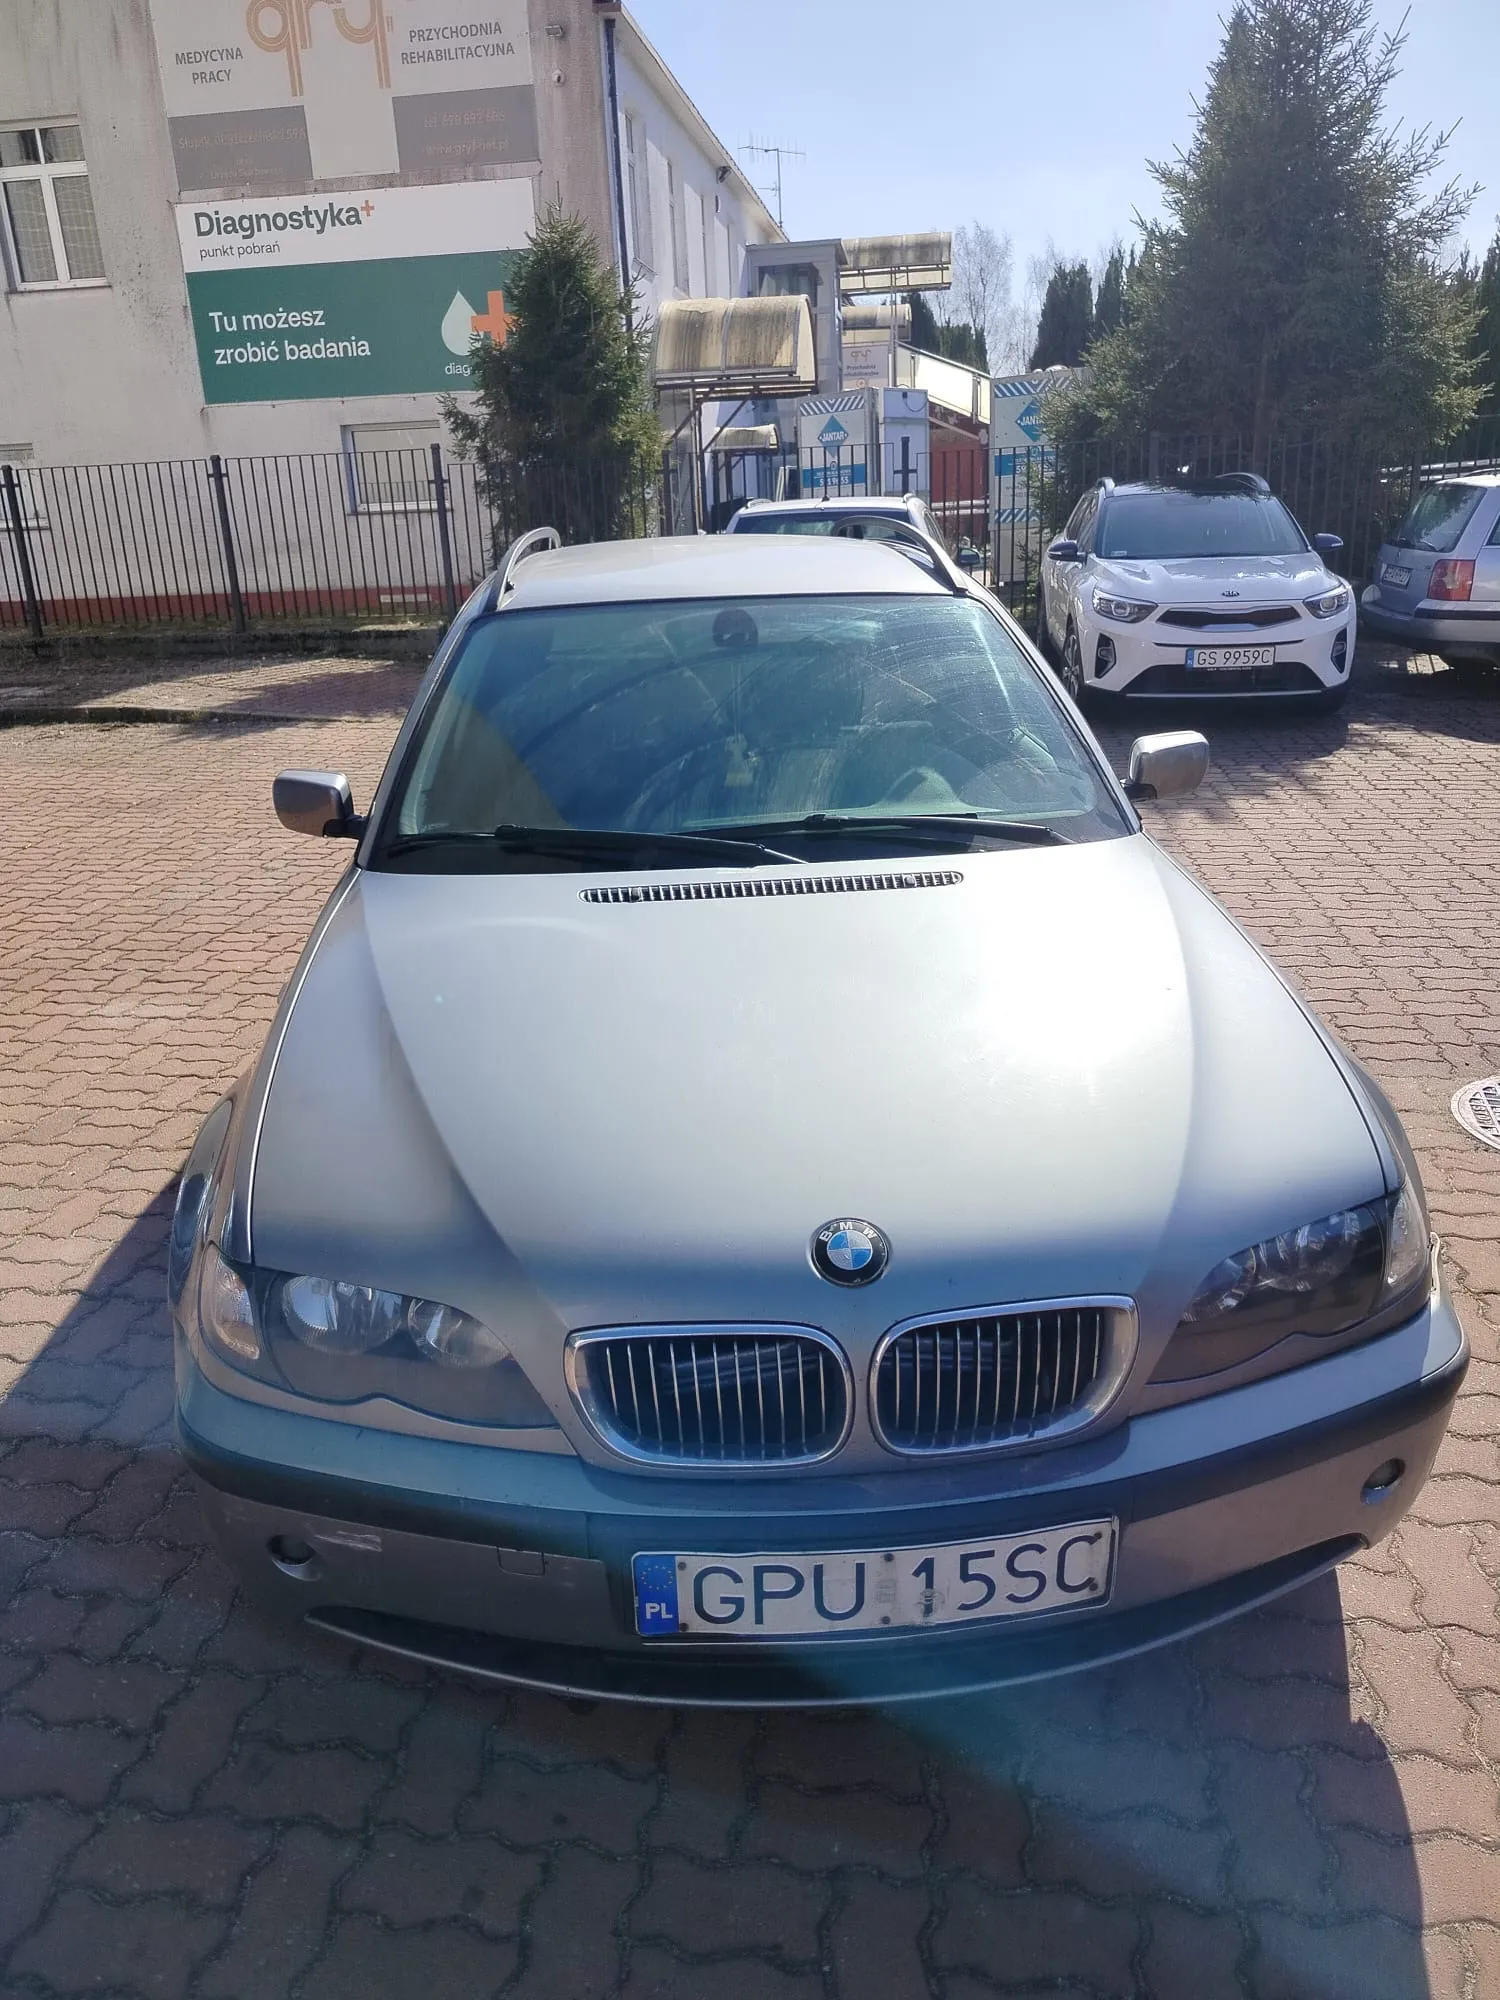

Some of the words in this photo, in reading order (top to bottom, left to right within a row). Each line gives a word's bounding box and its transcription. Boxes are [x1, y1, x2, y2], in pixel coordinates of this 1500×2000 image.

[409, 21, 502, 43] PRZYCHODNIA
[175, 47, 243, 65] MEDYCYNA
[401, 42, 515, 65] REHABILITACYJNA
[192, 69, 232, 84] PRACY
[194, 202, 362, 239] Diagnostyka
[200, 244, 234, 261] punkt
[237, 240, 280, 258] pobrań
[209, 311, 237, 332] Tu
[242, 307, 325, 331] możesz
[214, 341, 279, 365] zrobić
[284, 336, 371, 361] badania
[822, 431, 845, 442] JANTAR
[1197, 651, 1217, 666] GS
[1223, 649, 1270, 665] 9959C
[819, 1221, 877, 1242] BMW
[645, 1602, 673, 1619] PL
[693, 1562, 865, 1625] GPU
[911, 1534, 1101, 1617] 15SC
